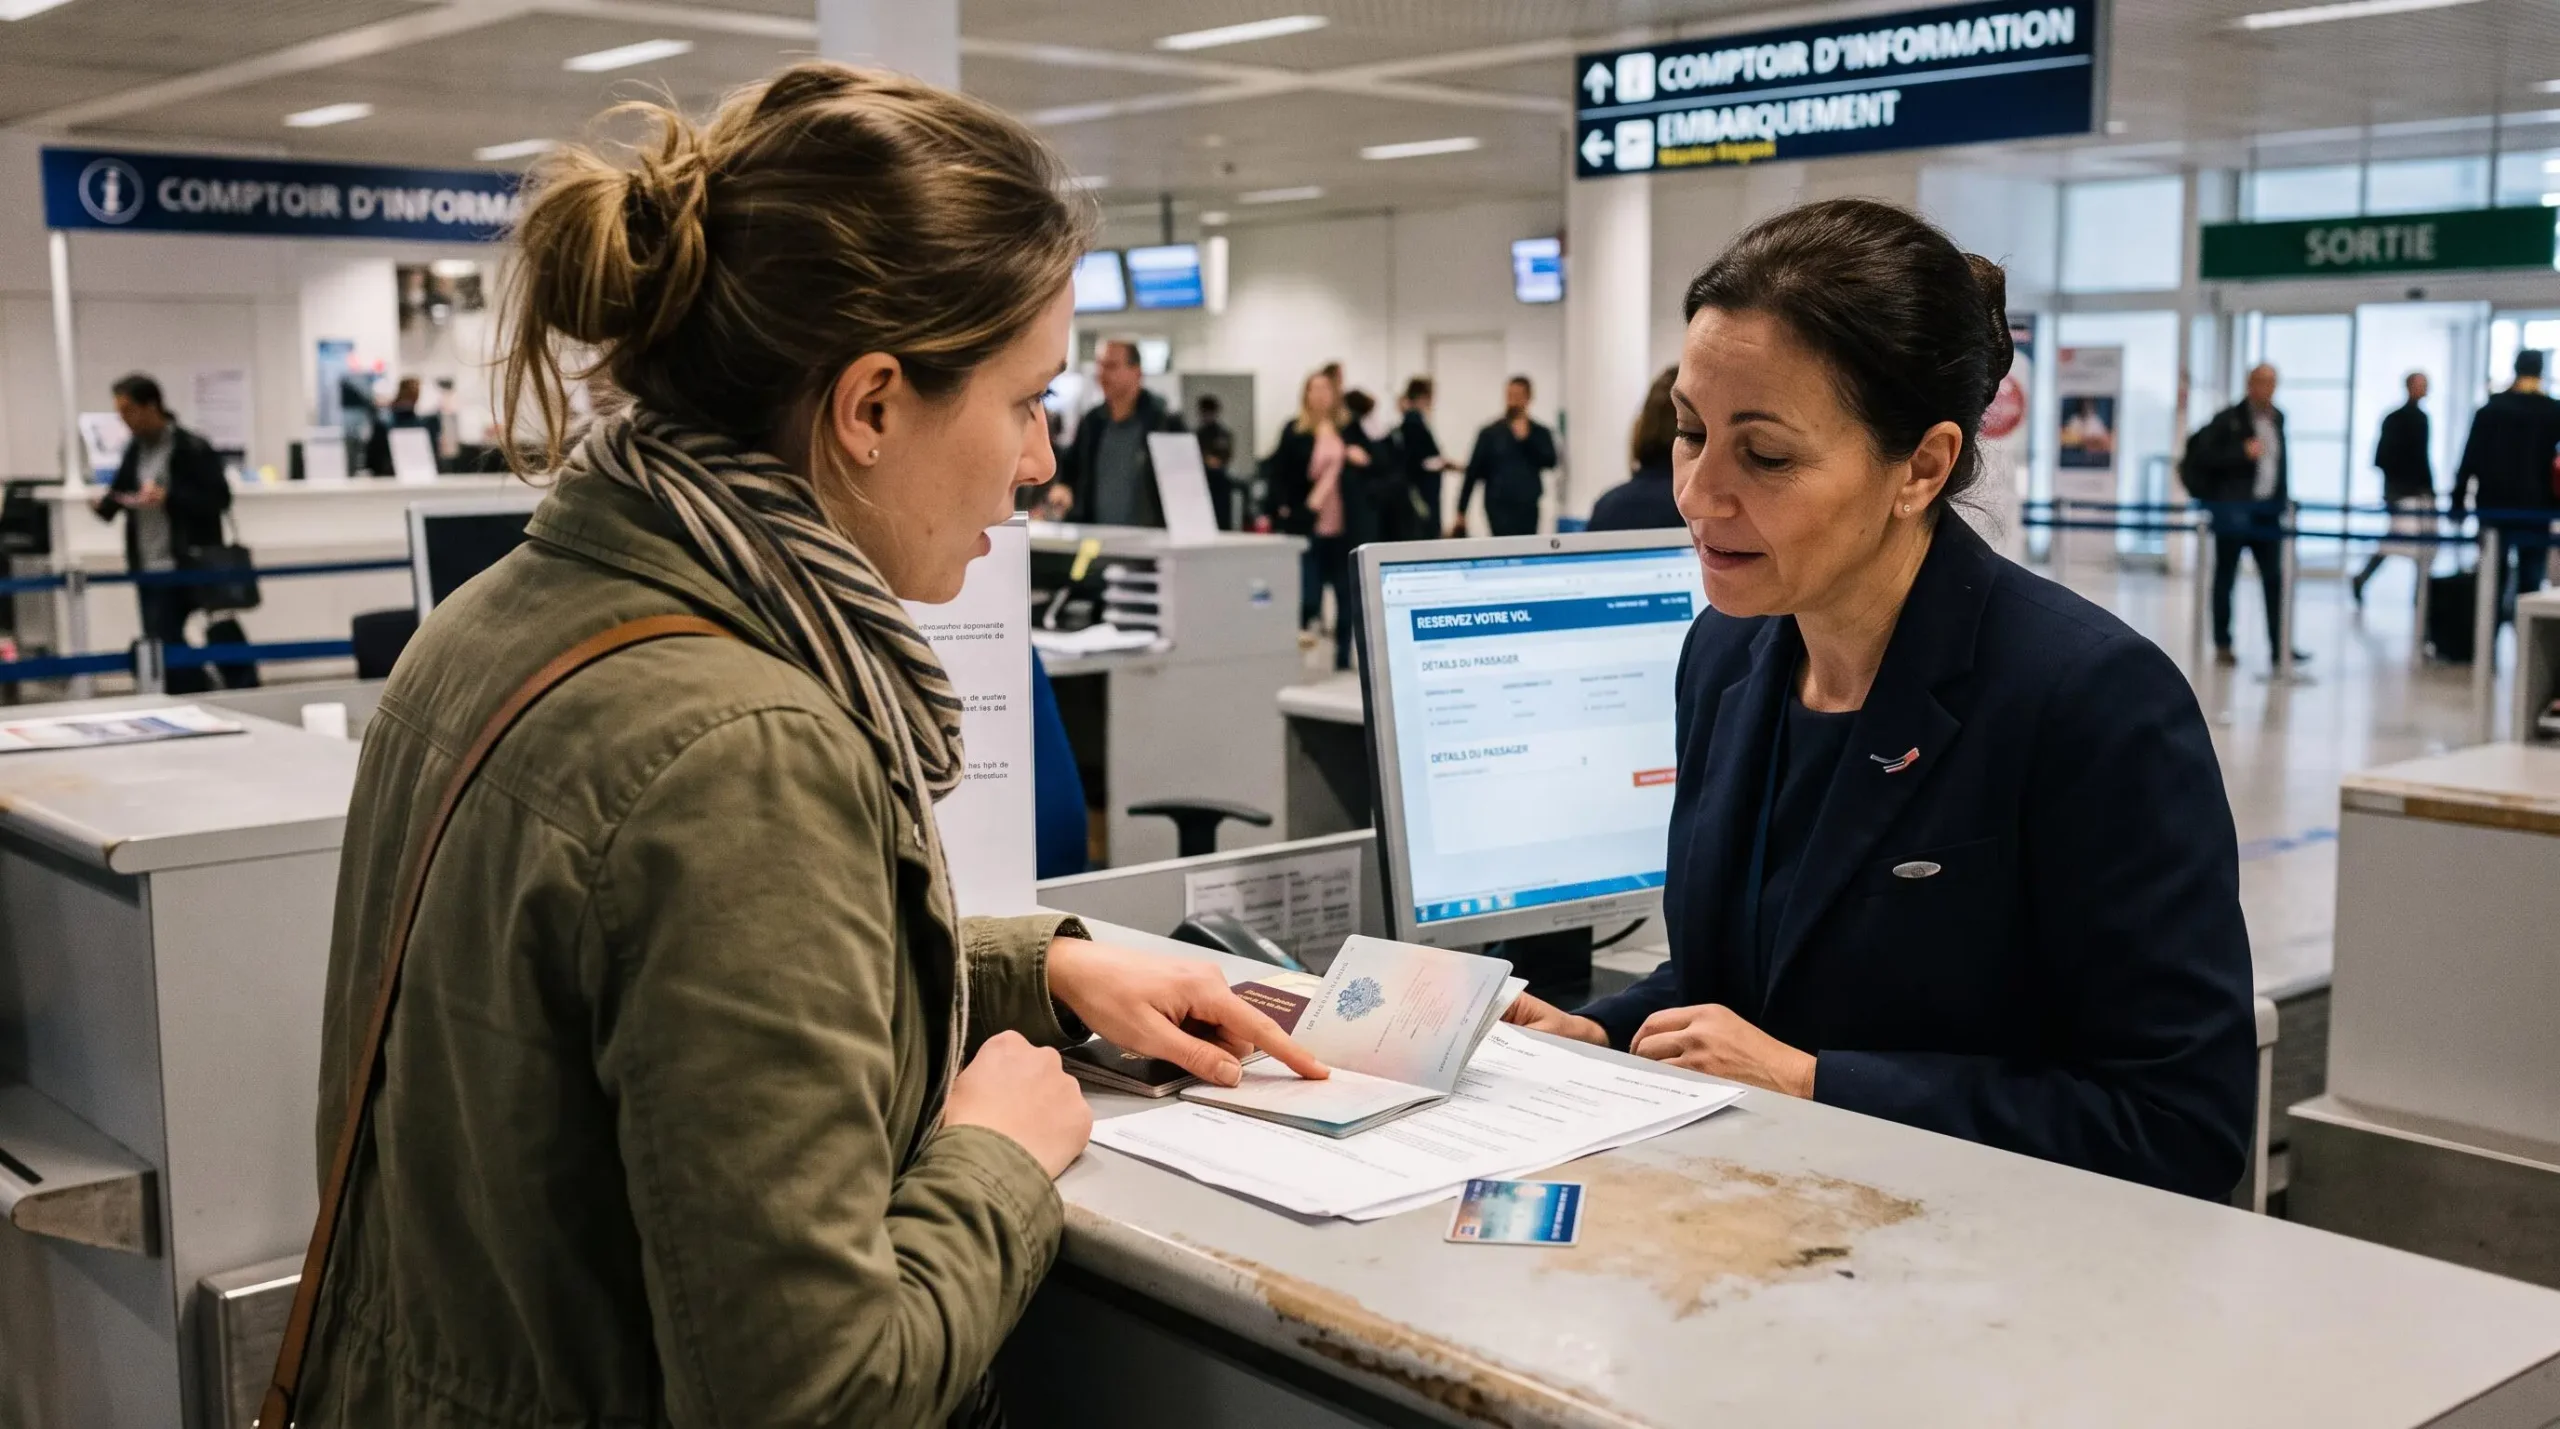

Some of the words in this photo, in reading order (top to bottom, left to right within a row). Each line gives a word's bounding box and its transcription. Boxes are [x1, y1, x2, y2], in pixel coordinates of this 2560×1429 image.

[1656, 39, 1809, 92] COMPTOIR
[1813, 7, 2076, 75] D'INFORMATION
[1656, 90, 1901, 147] EMBARQUEMENT
[157, 176, 343, 220] COMPTOIR
[2304, 223, 2437, 266] SORTIE
[1417, 613, 1473, 629] RESERVEZ
[1474, 611, 1509, 625] VOTRE
[1510, 609, 1532, 622] VOL
[1460, 658, 1472, 668] DU
